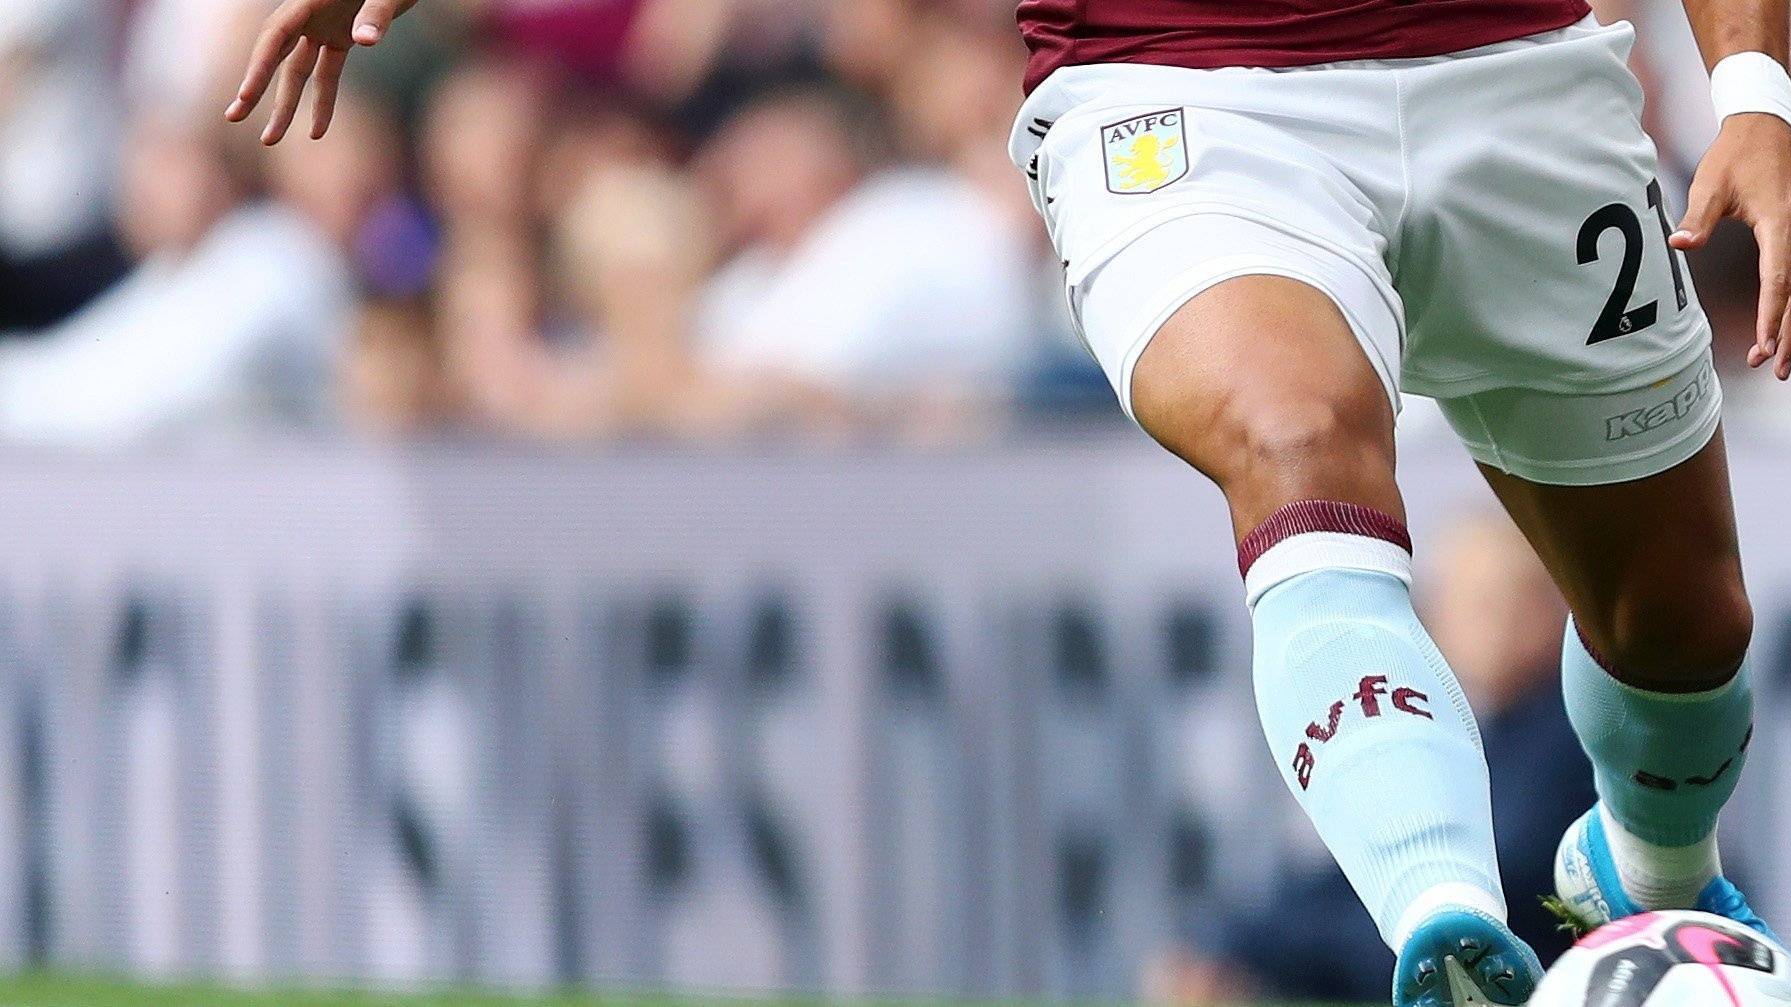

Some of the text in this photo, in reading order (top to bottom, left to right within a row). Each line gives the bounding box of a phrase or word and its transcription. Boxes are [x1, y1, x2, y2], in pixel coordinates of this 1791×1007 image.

[1109, 113, 1178, 143] AVFC
[1576, 177, 1688, 346] 21
[1606, 358, 1712, 441] Kapp
[1292, 675, 1434, 791] avfc
